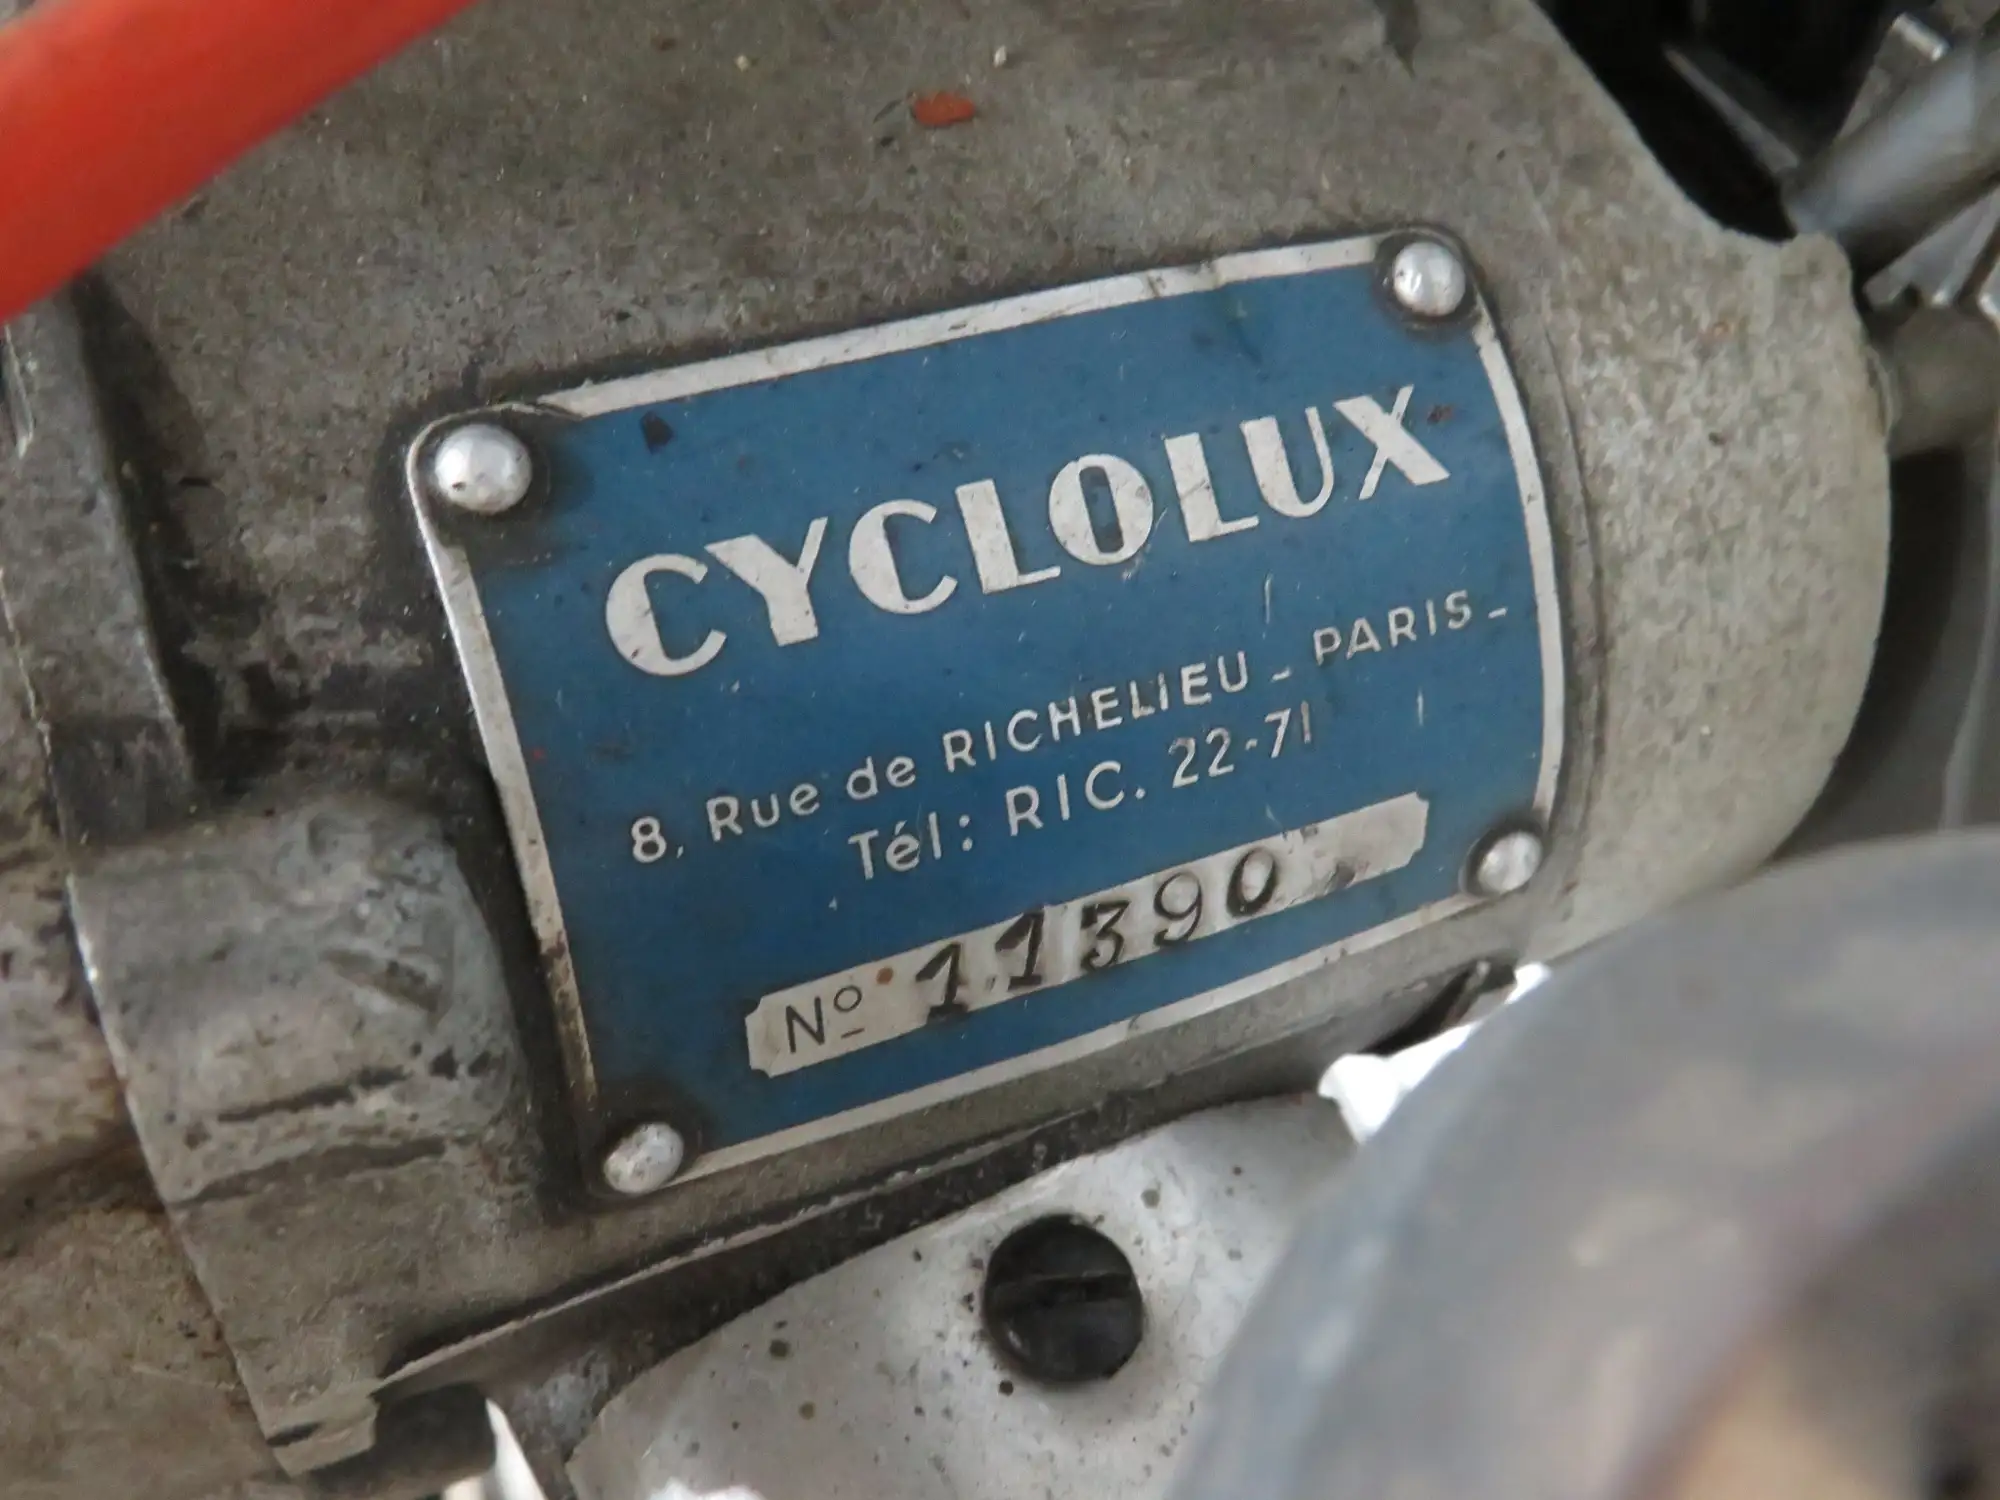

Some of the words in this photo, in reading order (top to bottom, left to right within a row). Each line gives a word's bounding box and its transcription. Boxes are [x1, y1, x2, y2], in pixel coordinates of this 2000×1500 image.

[605, 385, 1450, 677] CYCLOLUX
[705, 782, 820, 842] Rue
[846, 755, 917, 800] de
[942, 650, 1249, 774] RICHELIEU
[1005, 760, 1147, 837] RIC.
[1167, 701, 1312, 788] 22-71
[914, 846, 1280, 1025] 11390
